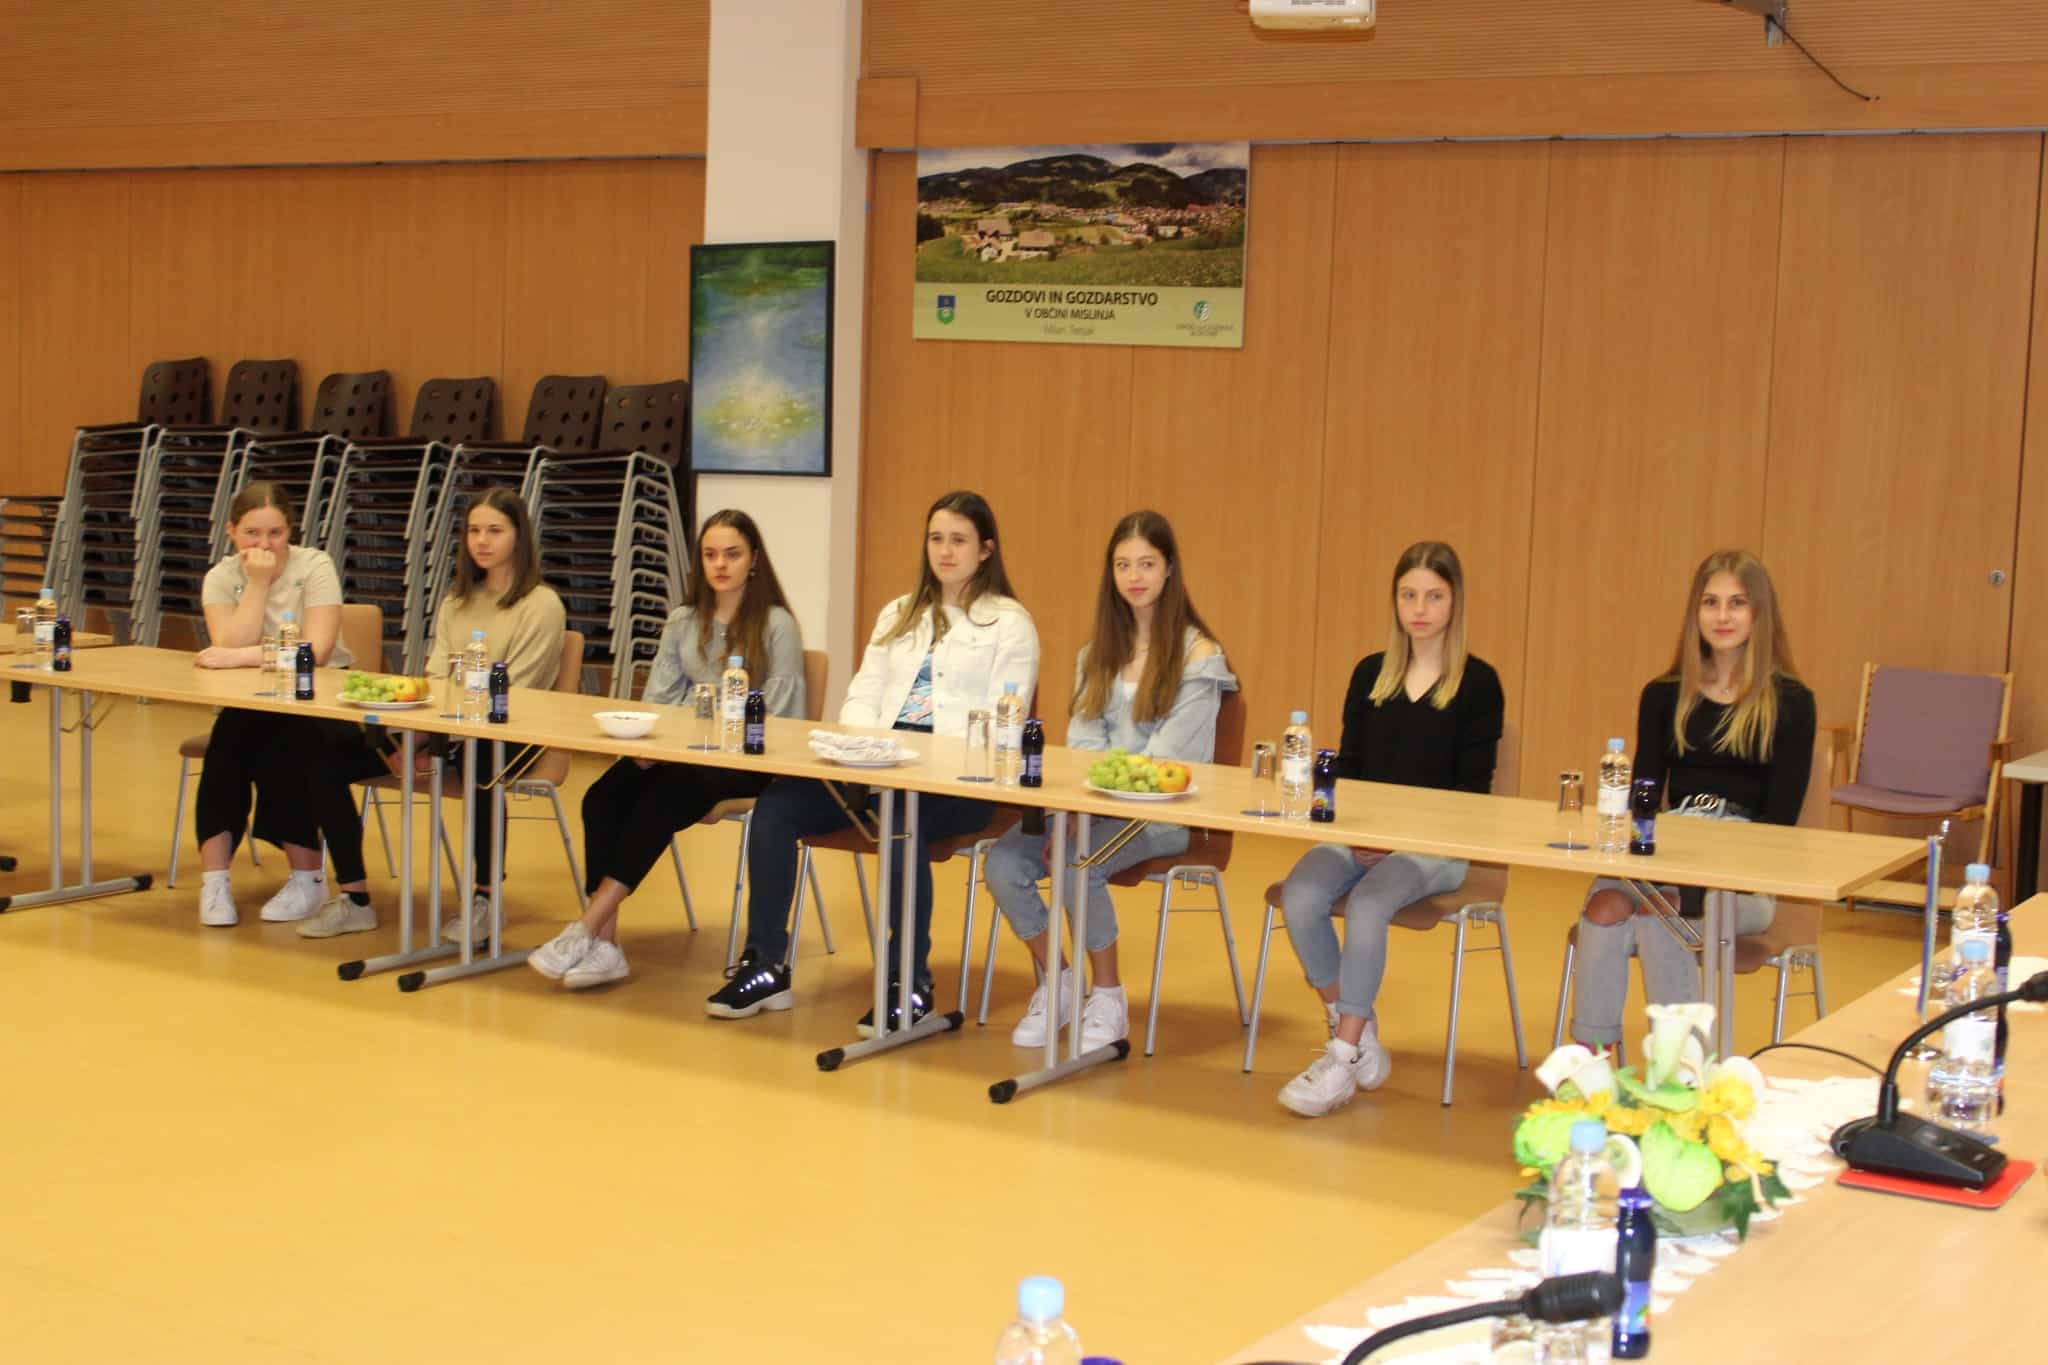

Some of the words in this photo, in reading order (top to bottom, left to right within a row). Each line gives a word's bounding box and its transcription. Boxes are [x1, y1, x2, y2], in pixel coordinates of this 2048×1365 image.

[986, 290, 1046, 303] GOZDOVI
[1050, 291, 1062, 304] IN
[1066, 291, 1158, 306] GOZDARSTVO
[1024, 308, 1033, 318] V
[1070, 309, 1115, 320] MISLINJA
